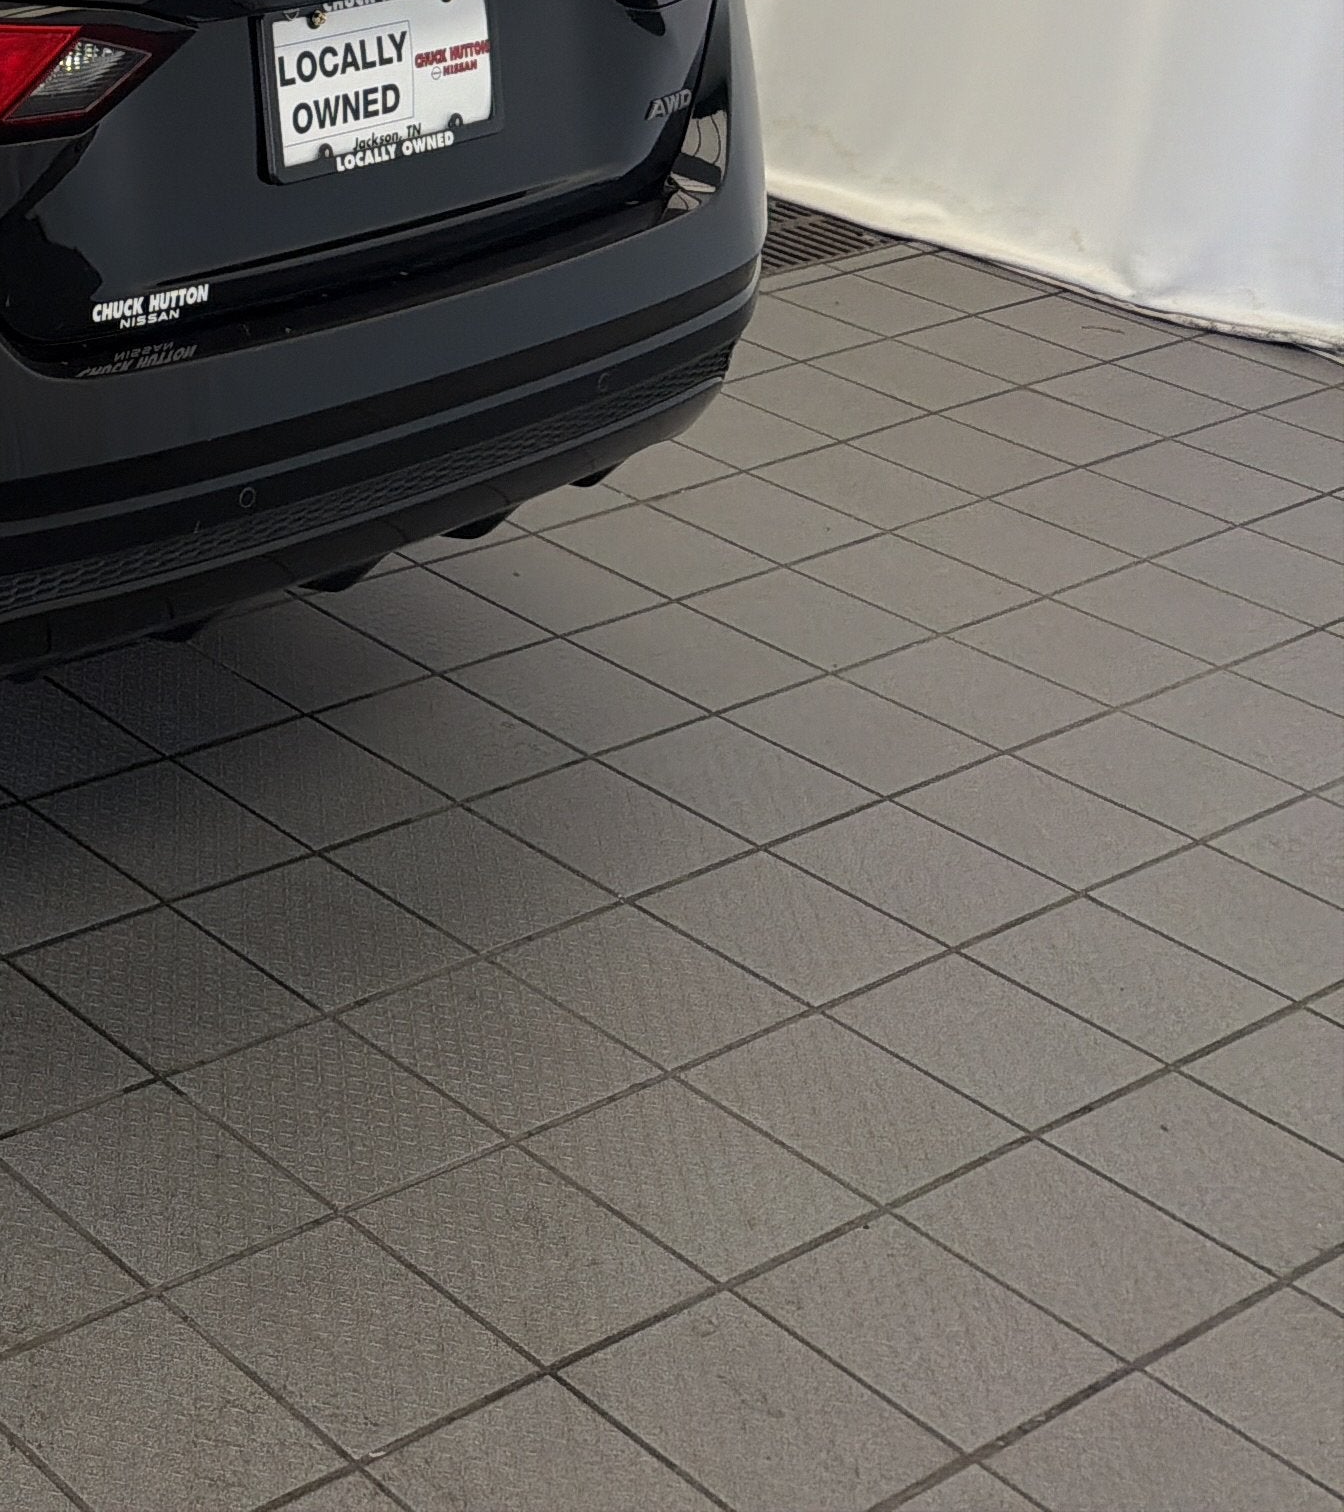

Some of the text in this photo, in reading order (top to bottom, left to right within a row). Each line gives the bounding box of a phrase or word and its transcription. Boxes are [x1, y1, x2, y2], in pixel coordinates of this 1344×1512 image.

[277, 31, 407, 87] LOCALLY
[415, 48, 447, 68] CHUCK
[443, 59, 478, 76] NISSAN
[292, 84, 400, 135] OWNED
[646, 88, 692, 120] AWD
[406, 122, 422, 138] TN
[335, 130, 454, 172] LOCALLY OWNED
[92, 283, 210, 323] CHUCK HUTTON
[119, 308, 181, 330] NISSAN
